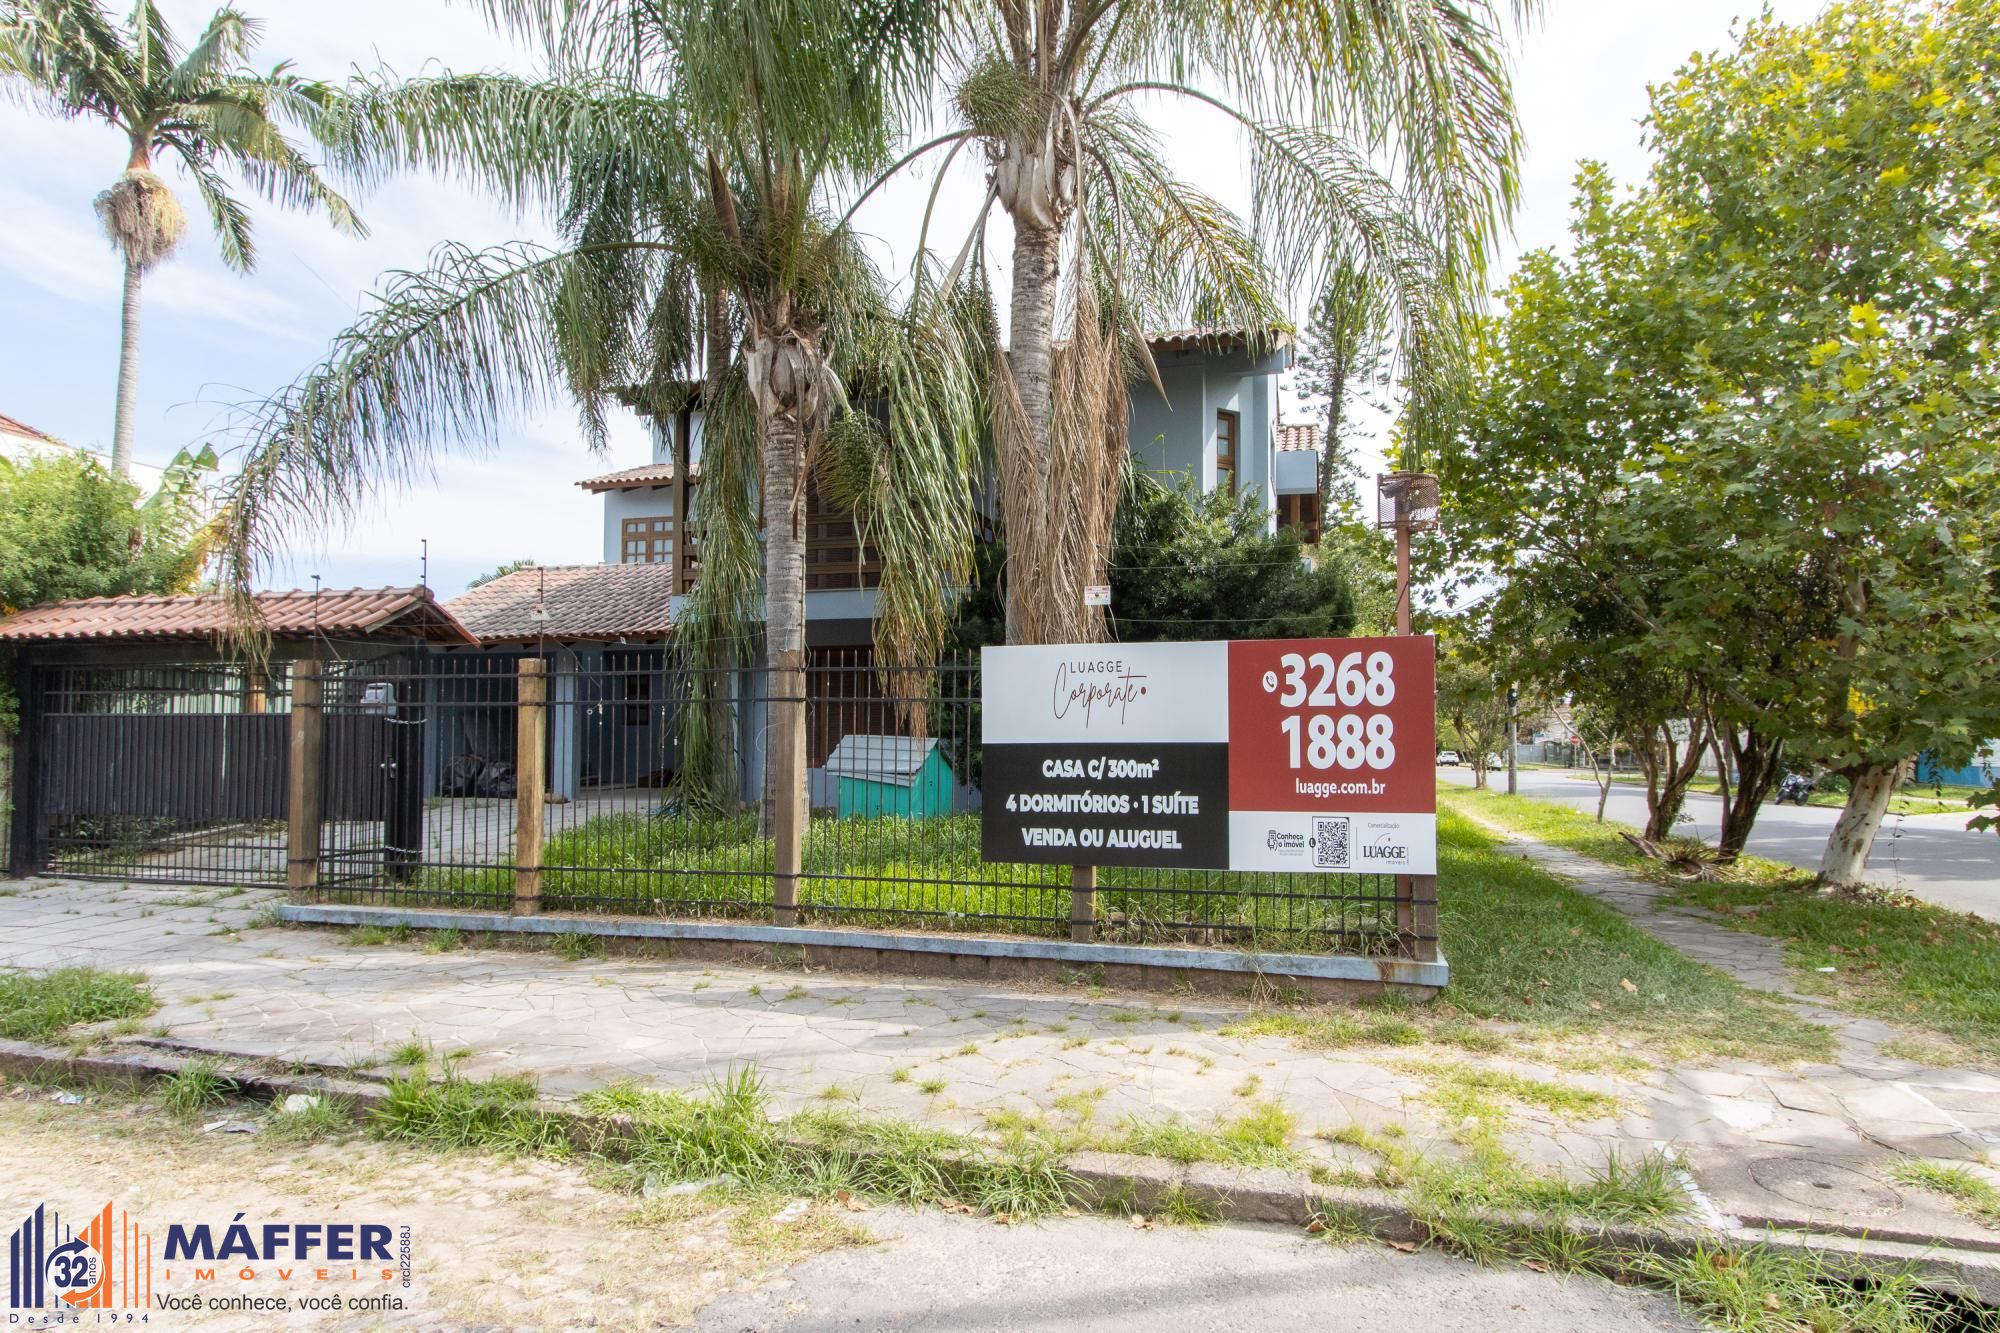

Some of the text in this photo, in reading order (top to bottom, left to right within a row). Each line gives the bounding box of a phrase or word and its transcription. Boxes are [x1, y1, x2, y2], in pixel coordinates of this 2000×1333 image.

[1070, 660, 1123, 674] LUAGGE
[1280, 651, 1396, 708] 3268
[1281, 713, 1396, 770] 1888
[1042, 756, 1160, 780] CASA C/ 300m²
[1295, 777, 1386, 798] luagge.com.br
[1005, 790, 1200, 815] 4 DORMITÓRIOS 1 SUÍTE
[1021, 827, 1183, 849] VENDA OU ALUGUEL
[1283, 840, 1305, 848] imóvel
[1363, 845, 1406, 859] LUAGGE
